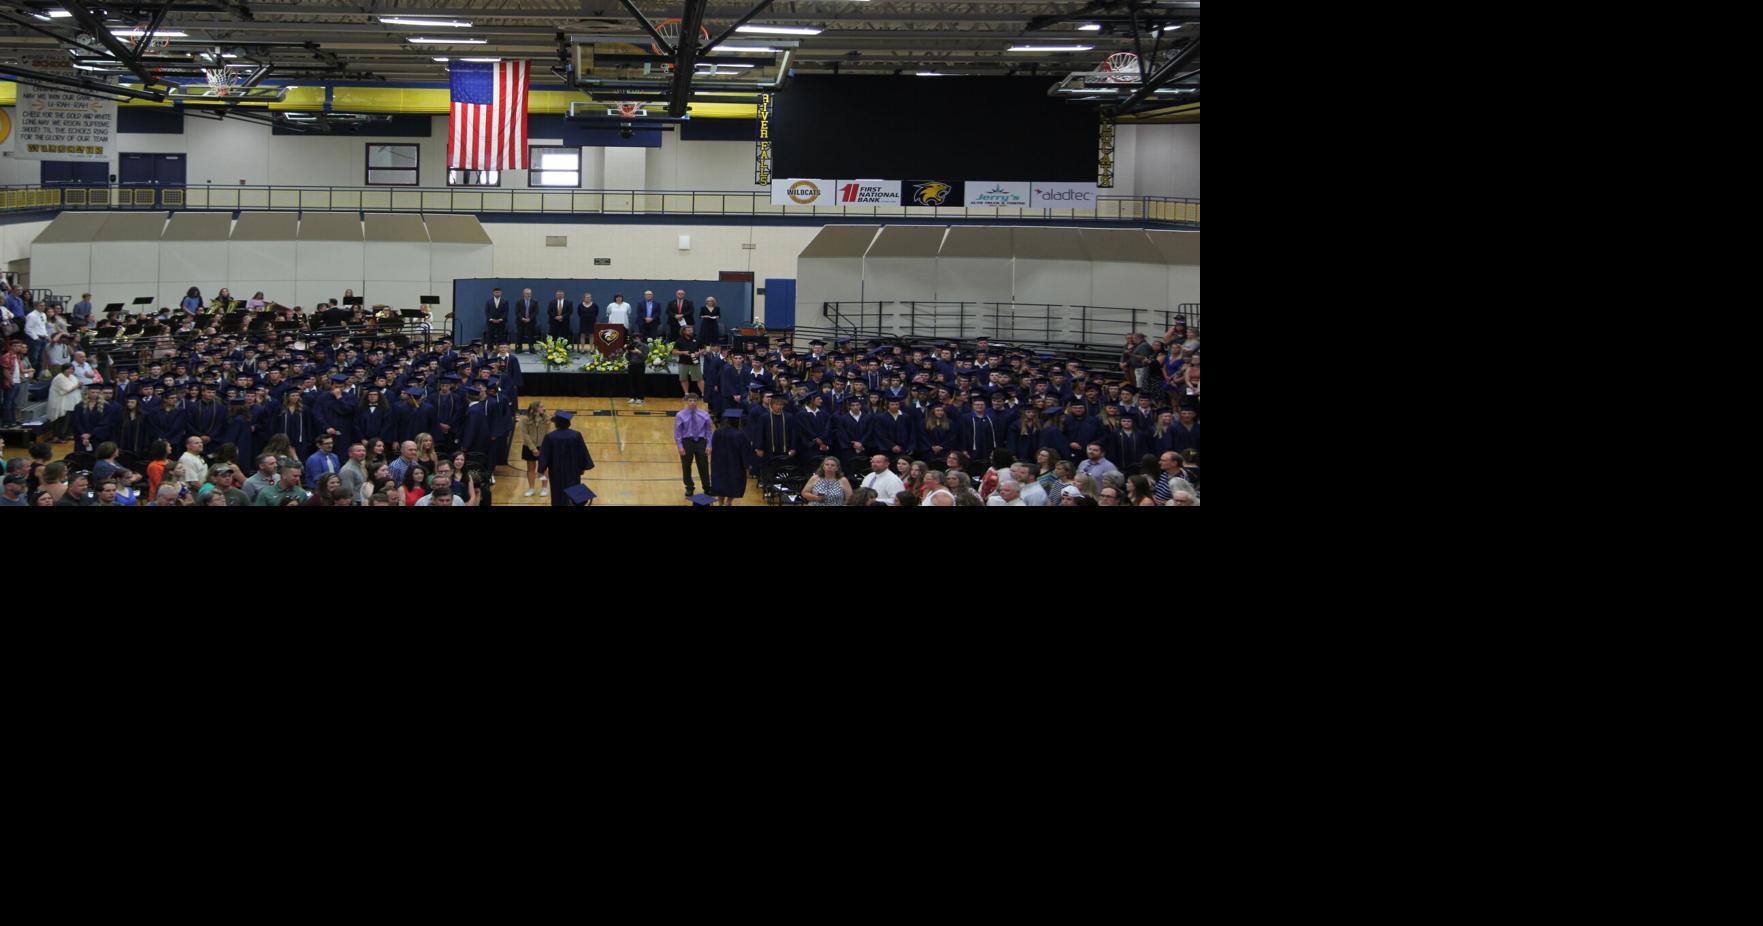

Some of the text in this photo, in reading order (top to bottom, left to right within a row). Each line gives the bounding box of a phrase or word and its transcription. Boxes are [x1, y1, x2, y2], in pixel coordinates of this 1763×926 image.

[760, 94, 769, 186] RIVER FALLS
[27, 144, 104, 154] WILDCATS
[976, 193, 1020, 202] Jerry's
[1042, 188, 1090, 200] aladtec
